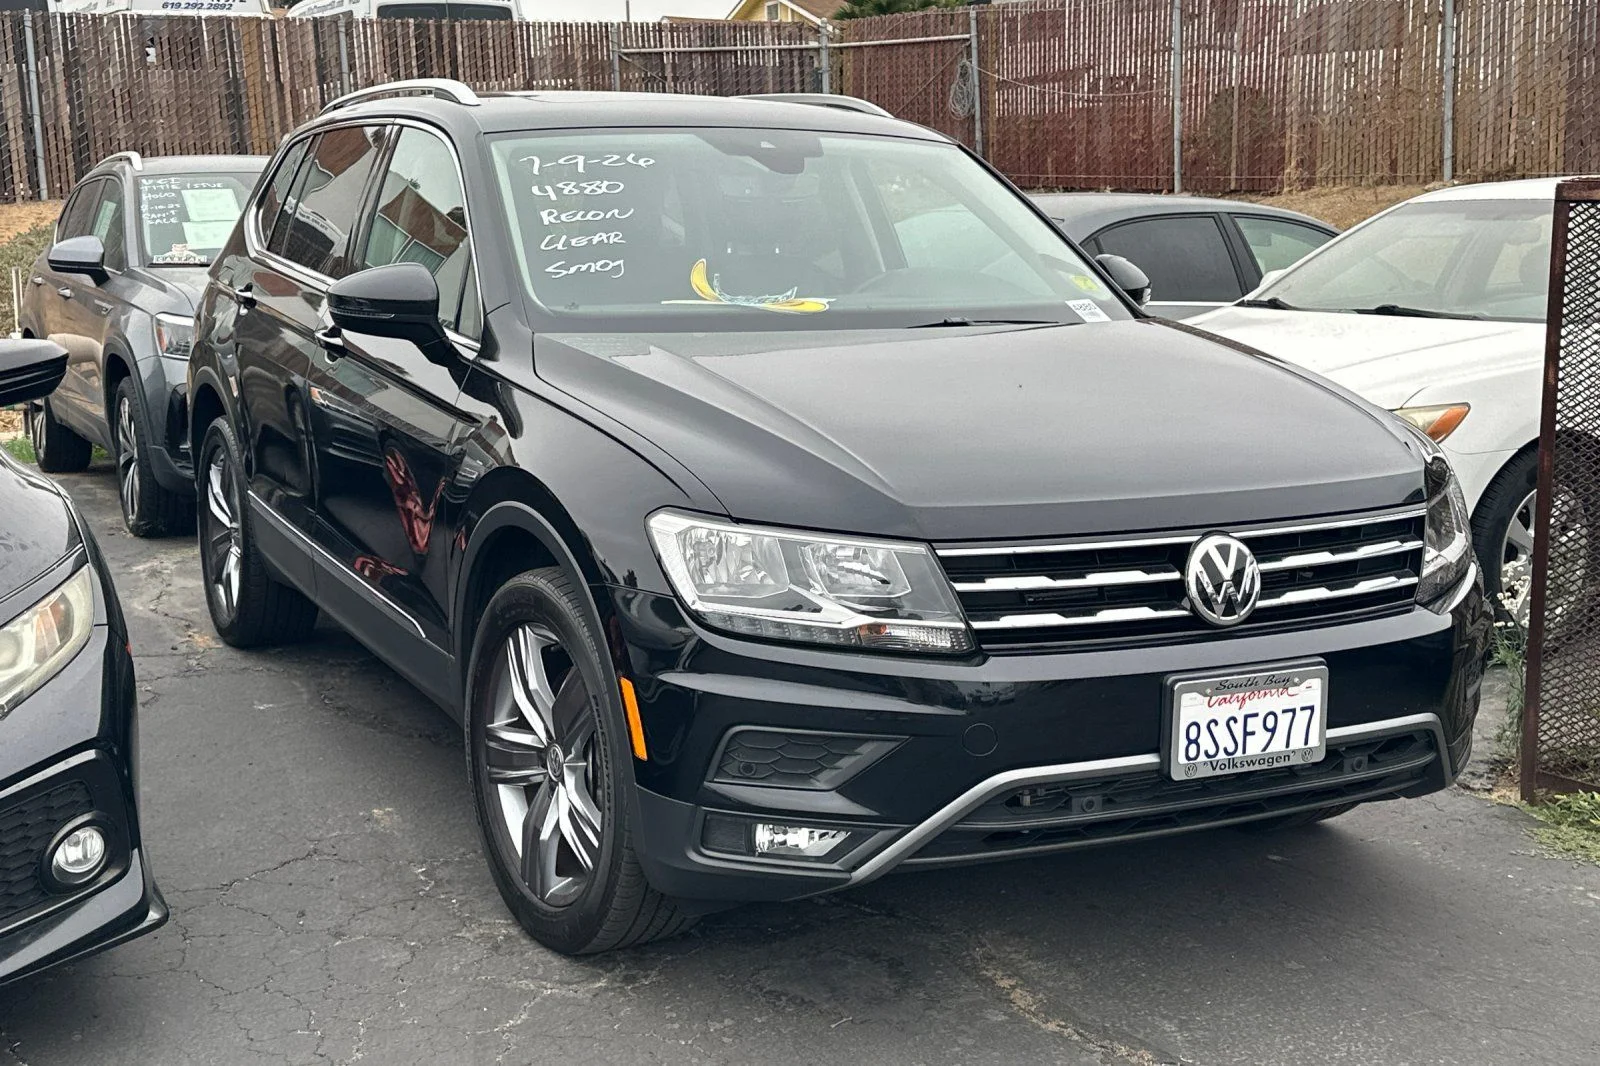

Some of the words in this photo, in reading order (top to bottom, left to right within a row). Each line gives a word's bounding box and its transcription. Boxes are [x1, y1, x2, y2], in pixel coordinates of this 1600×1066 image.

[161, 2, 233, 10] 619.292.2892
[519, 153, 655, 175] 7-9-26
[531, 180, 625, 200] 4880
[540, 208, 634, 225] RECON
[540, 232, 626, 250] CLEAR
[1215, 677, 1258, 691] South
[1264, 675, 1290, 686] Bay
[1208, 687, 1298, 709] California
[1184, 705, 1315, 762] 8SSF977
